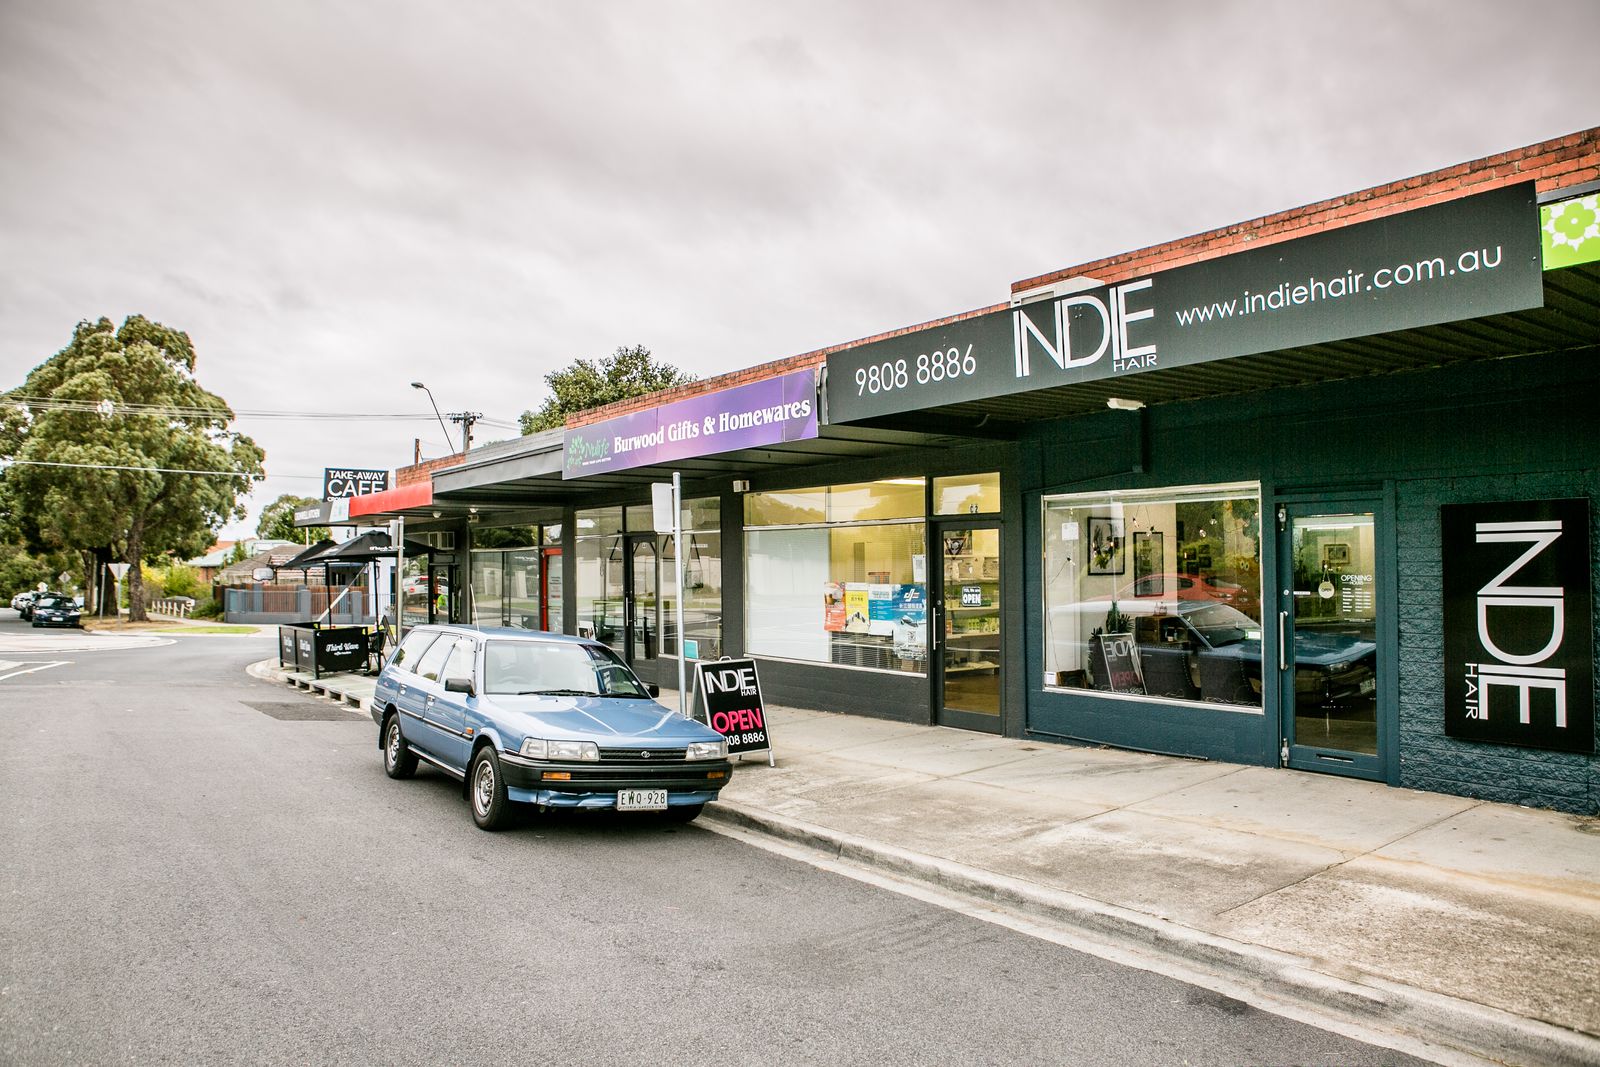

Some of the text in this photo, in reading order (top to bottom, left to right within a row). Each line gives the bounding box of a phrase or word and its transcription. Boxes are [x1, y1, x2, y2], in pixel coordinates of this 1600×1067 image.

[1175, 245, 1502, 327] www.indiehair.com.au
[1012, 278, 1157, 378] INDIE
[854, 343, 976, 397] 9808 8886
[1113, 354, 1158, 372] HAIR
[614, 399, 811, 453] Burwood Gifts & Homewares
[327, 479, 385, 497] CAFE
[328, 470, 385, 480] TAKE-AWAY
[963, 593, 981, 604] OPEN
[1475, 520, 1567, 728] INDIE
[704, 667, 757, 694] INDIE
[741, 688, 757, 696] HAIR
[1464, 663, 1479, 720] HAIR
[712, 708, 763, 734] OPEN
[742, 731, 765, 744] 8886
